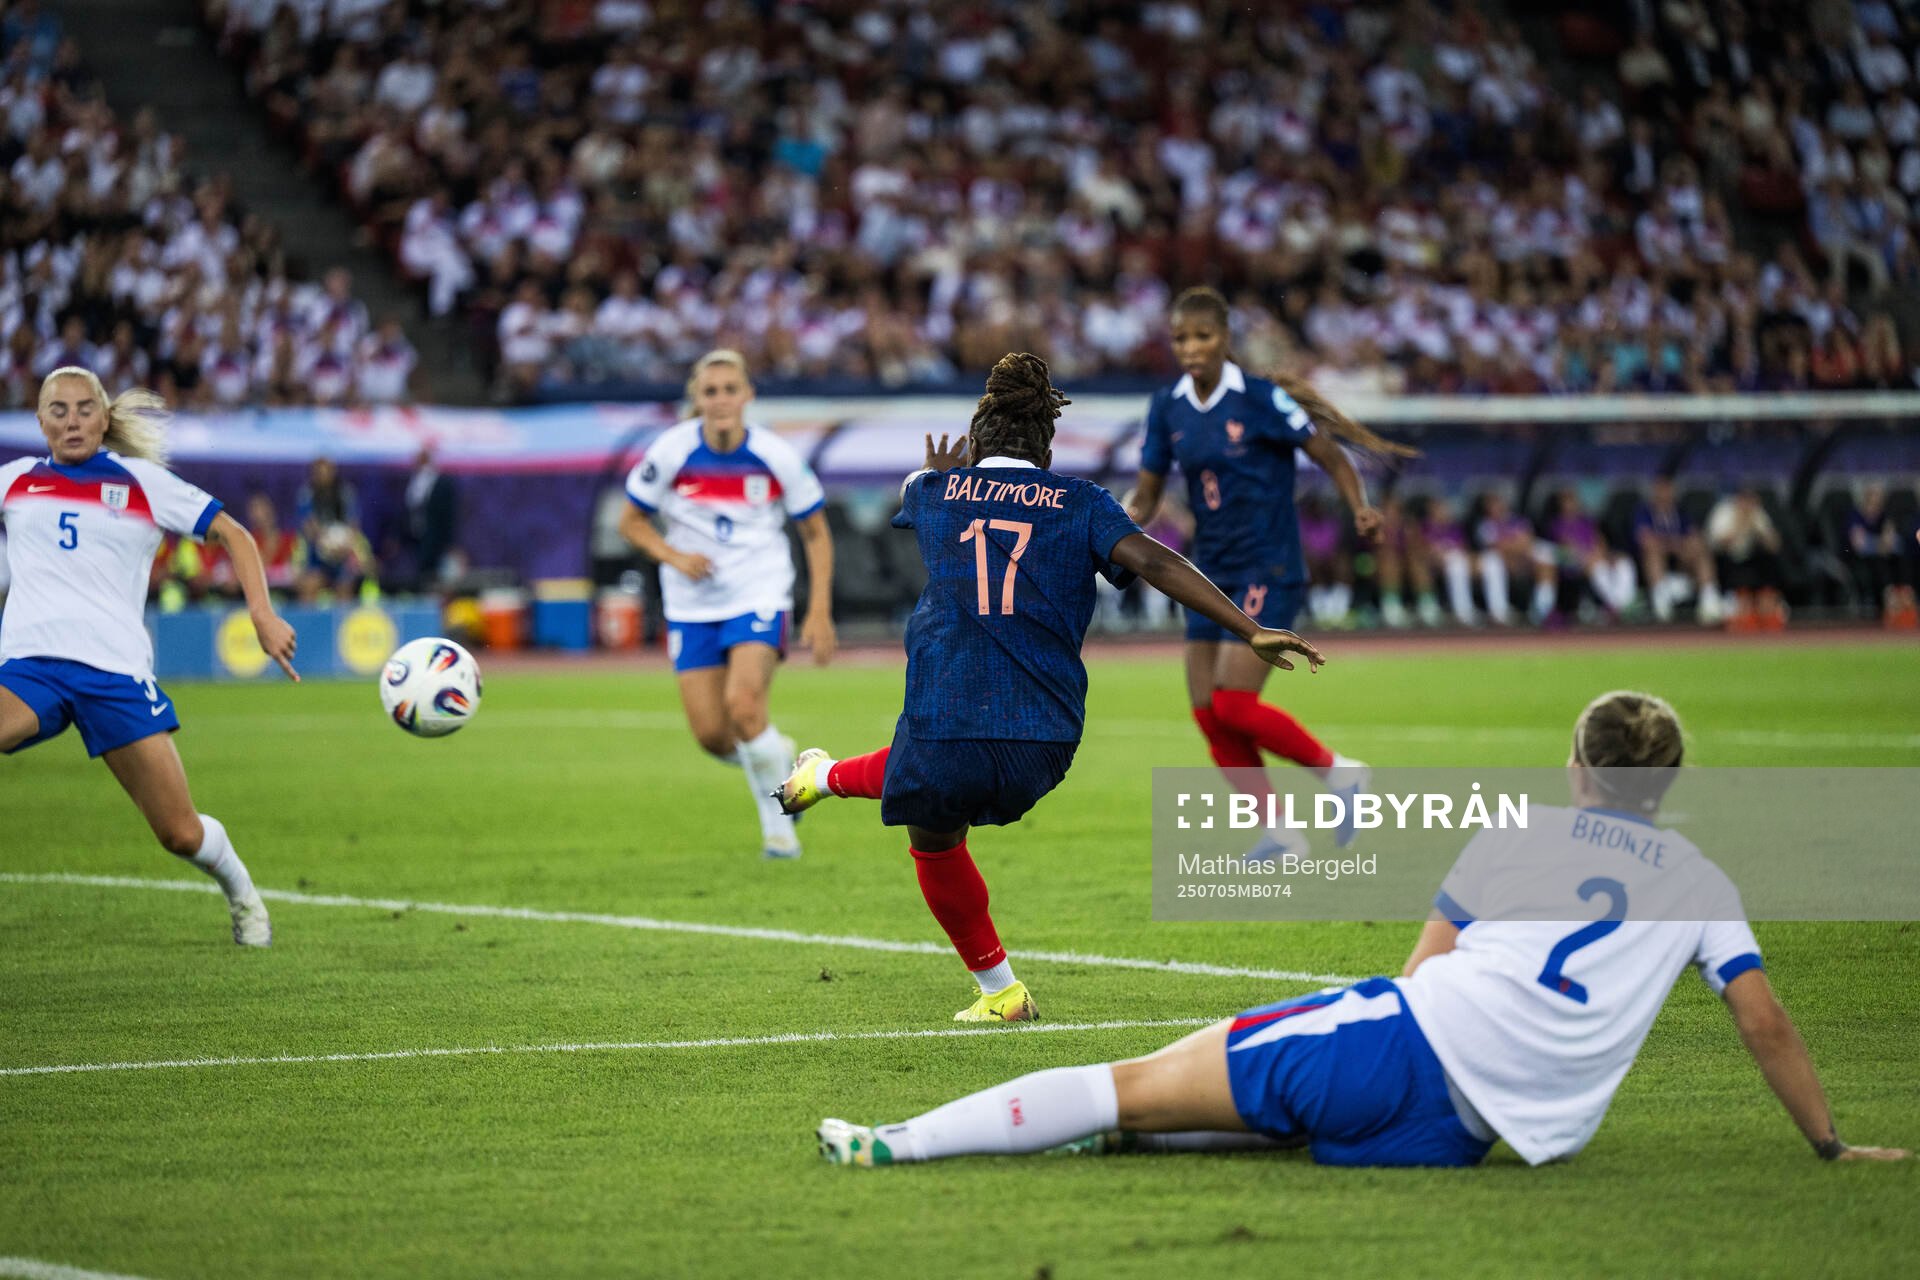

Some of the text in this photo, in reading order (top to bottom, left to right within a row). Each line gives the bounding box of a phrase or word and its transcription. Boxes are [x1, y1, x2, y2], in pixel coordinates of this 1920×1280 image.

[943, 473, 1067, 509] BALTIMORE
[58, 511, 80, 550] 5
[959, 518, 1033, 615] 17
[1571, 813, 1668, 869] BRONZE
[1537, 876, 1629, 1005] 2
